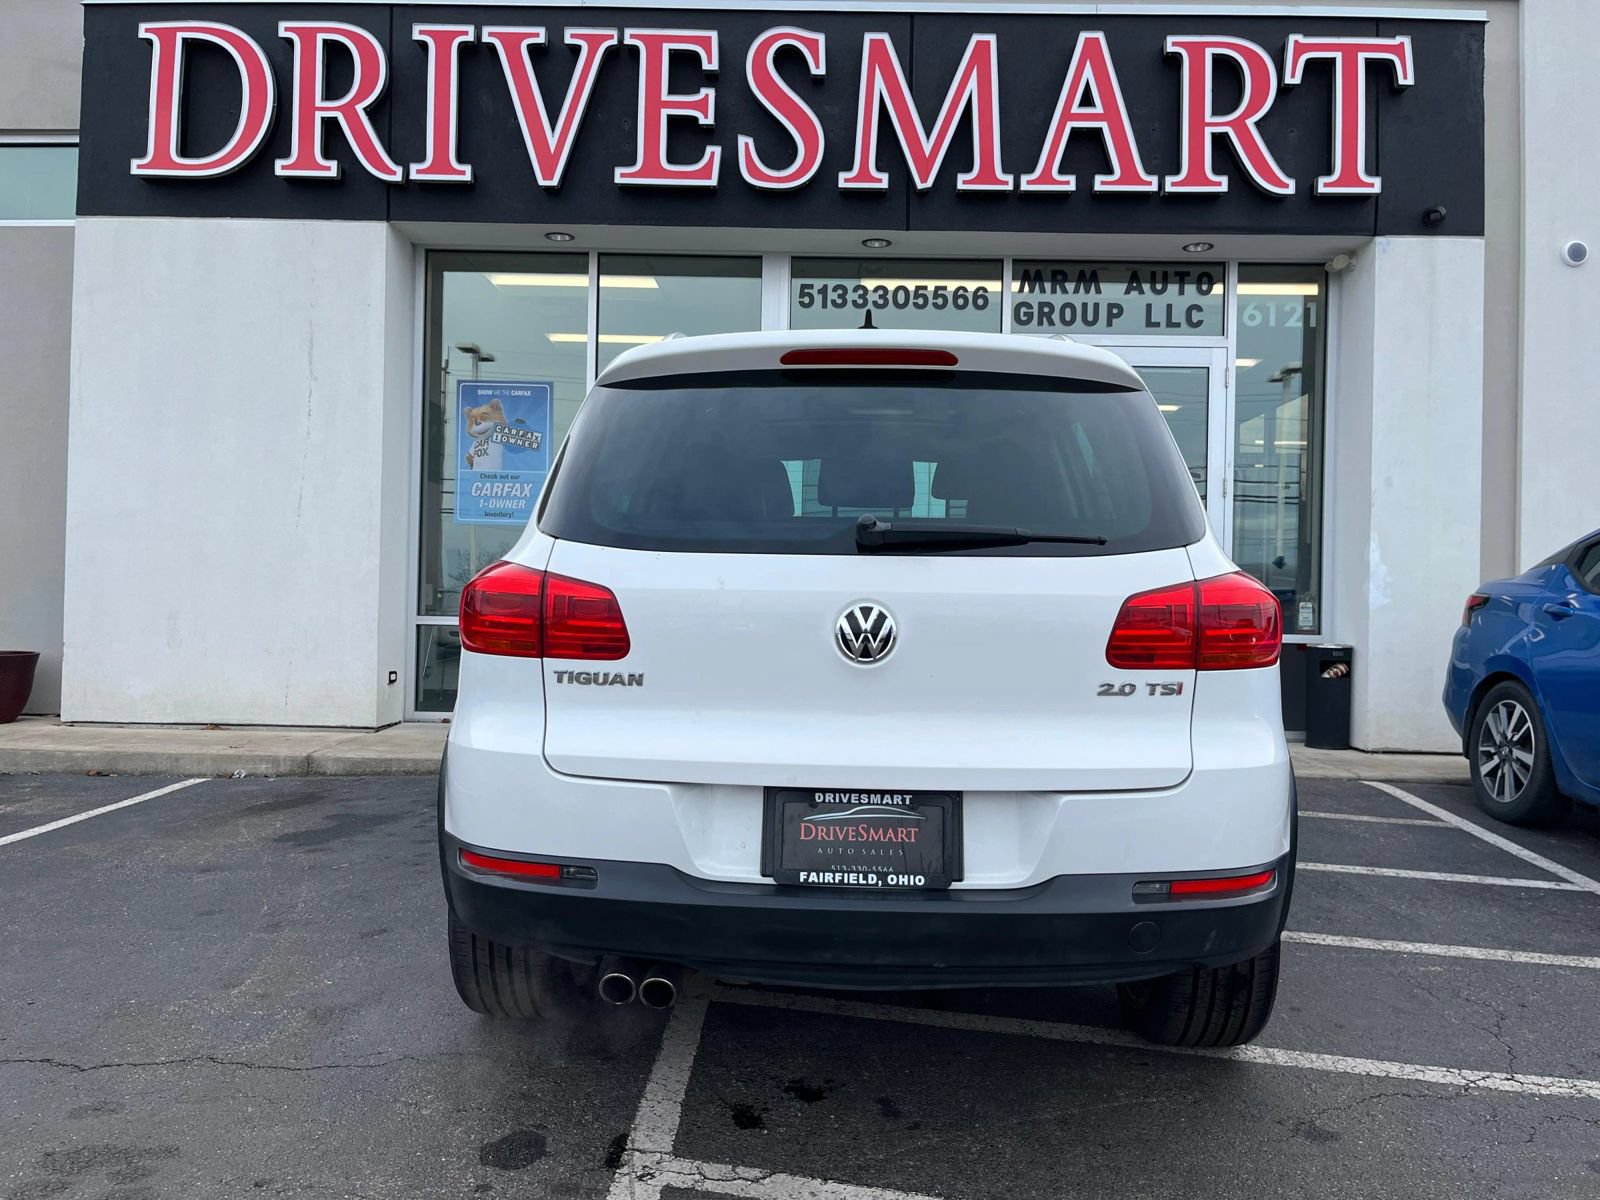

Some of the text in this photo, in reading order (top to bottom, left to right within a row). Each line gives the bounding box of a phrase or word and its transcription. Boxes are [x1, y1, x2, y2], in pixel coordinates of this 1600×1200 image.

[130, 21, 1415, 196] DRIVESMART
[1017, 269, 1214, 296] MRM AUTO
[798, 283, 989, 311] 5133305566
[1012, 302, 1205, 329] GROUP LLC
[1242, 302, 1317, 328] 6121
[495, 425, 541, 441] CARFAX
[501, 436, 538, 449] OWNER
[474, 447, 489, 458] FOX
[471, 482, 532, 497] CARFAX
[479, 499, 526, 509] 1-OWNER
[553, 670, 644, 687] TIGUAN
[815, 793, 912, 805] DRIVESMART
[862, 848, 904, 856] SALES
[799, 872, 926, 887] FAIRFIELD, OHIO
